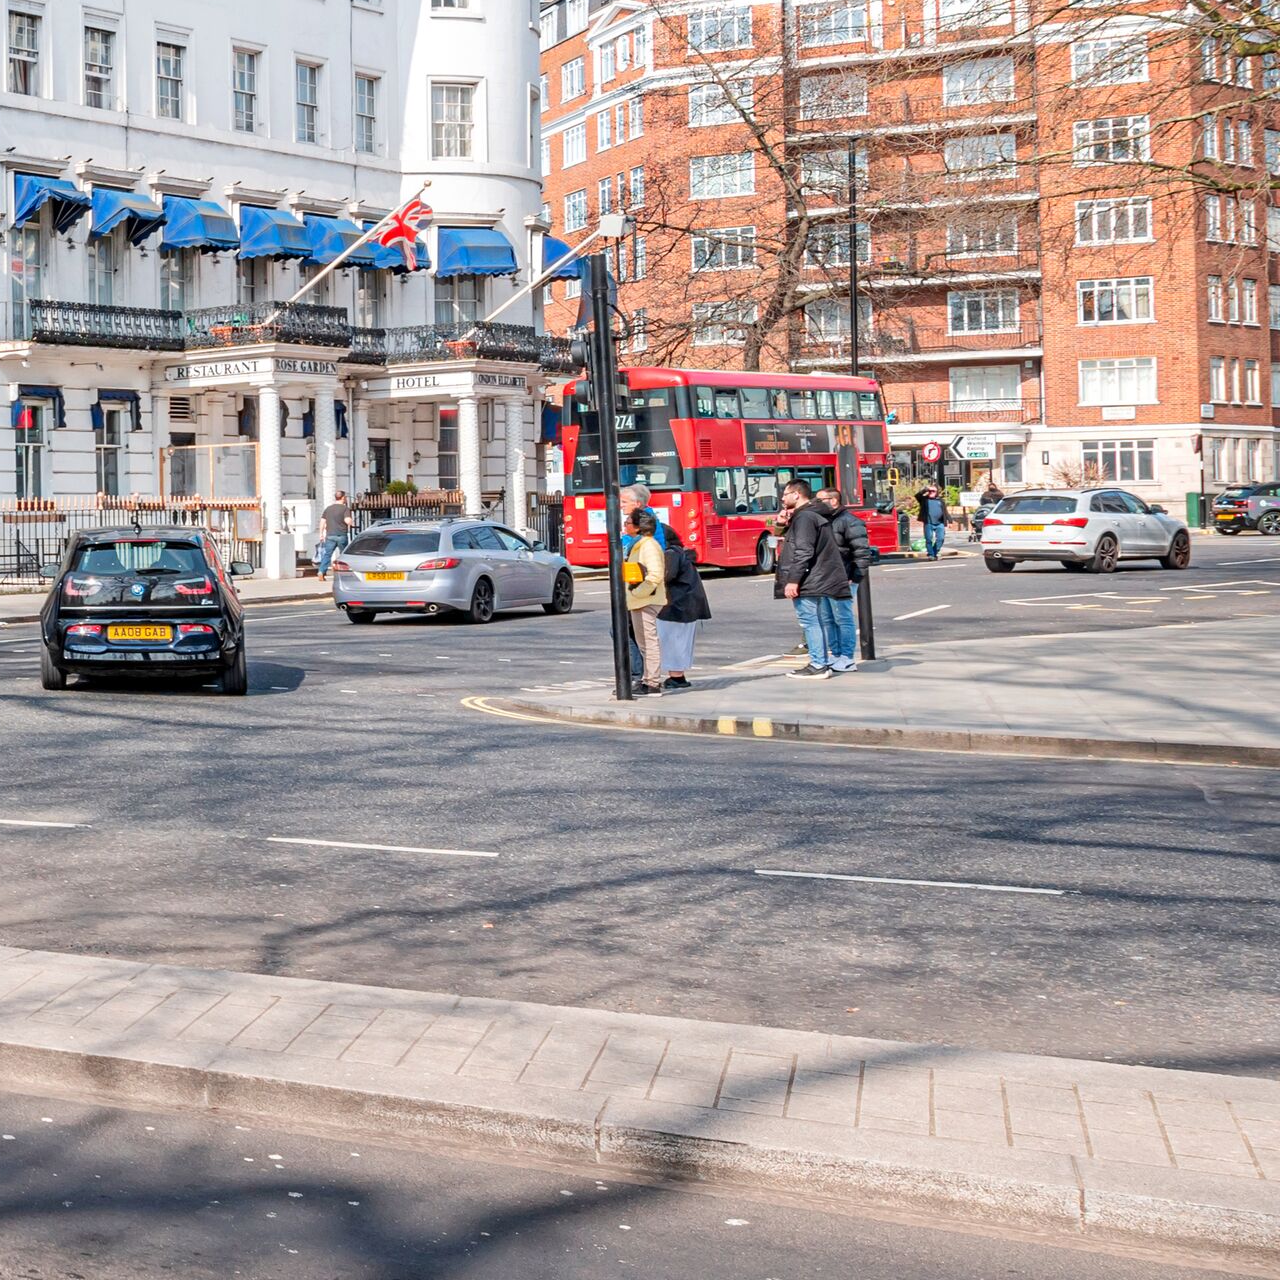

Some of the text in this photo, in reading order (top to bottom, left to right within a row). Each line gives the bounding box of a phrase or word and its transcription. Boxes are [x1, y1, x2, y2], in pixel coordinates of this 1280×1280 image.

[177, 361, 259, 378] RESTAURANT
[275, 359, 337, 373] ROSE GARDEN
[396, 376, 439, 388] HOTEL
[615, 415, 633, 429] 274
[114, 627, 166, 637] AA08 GAB
